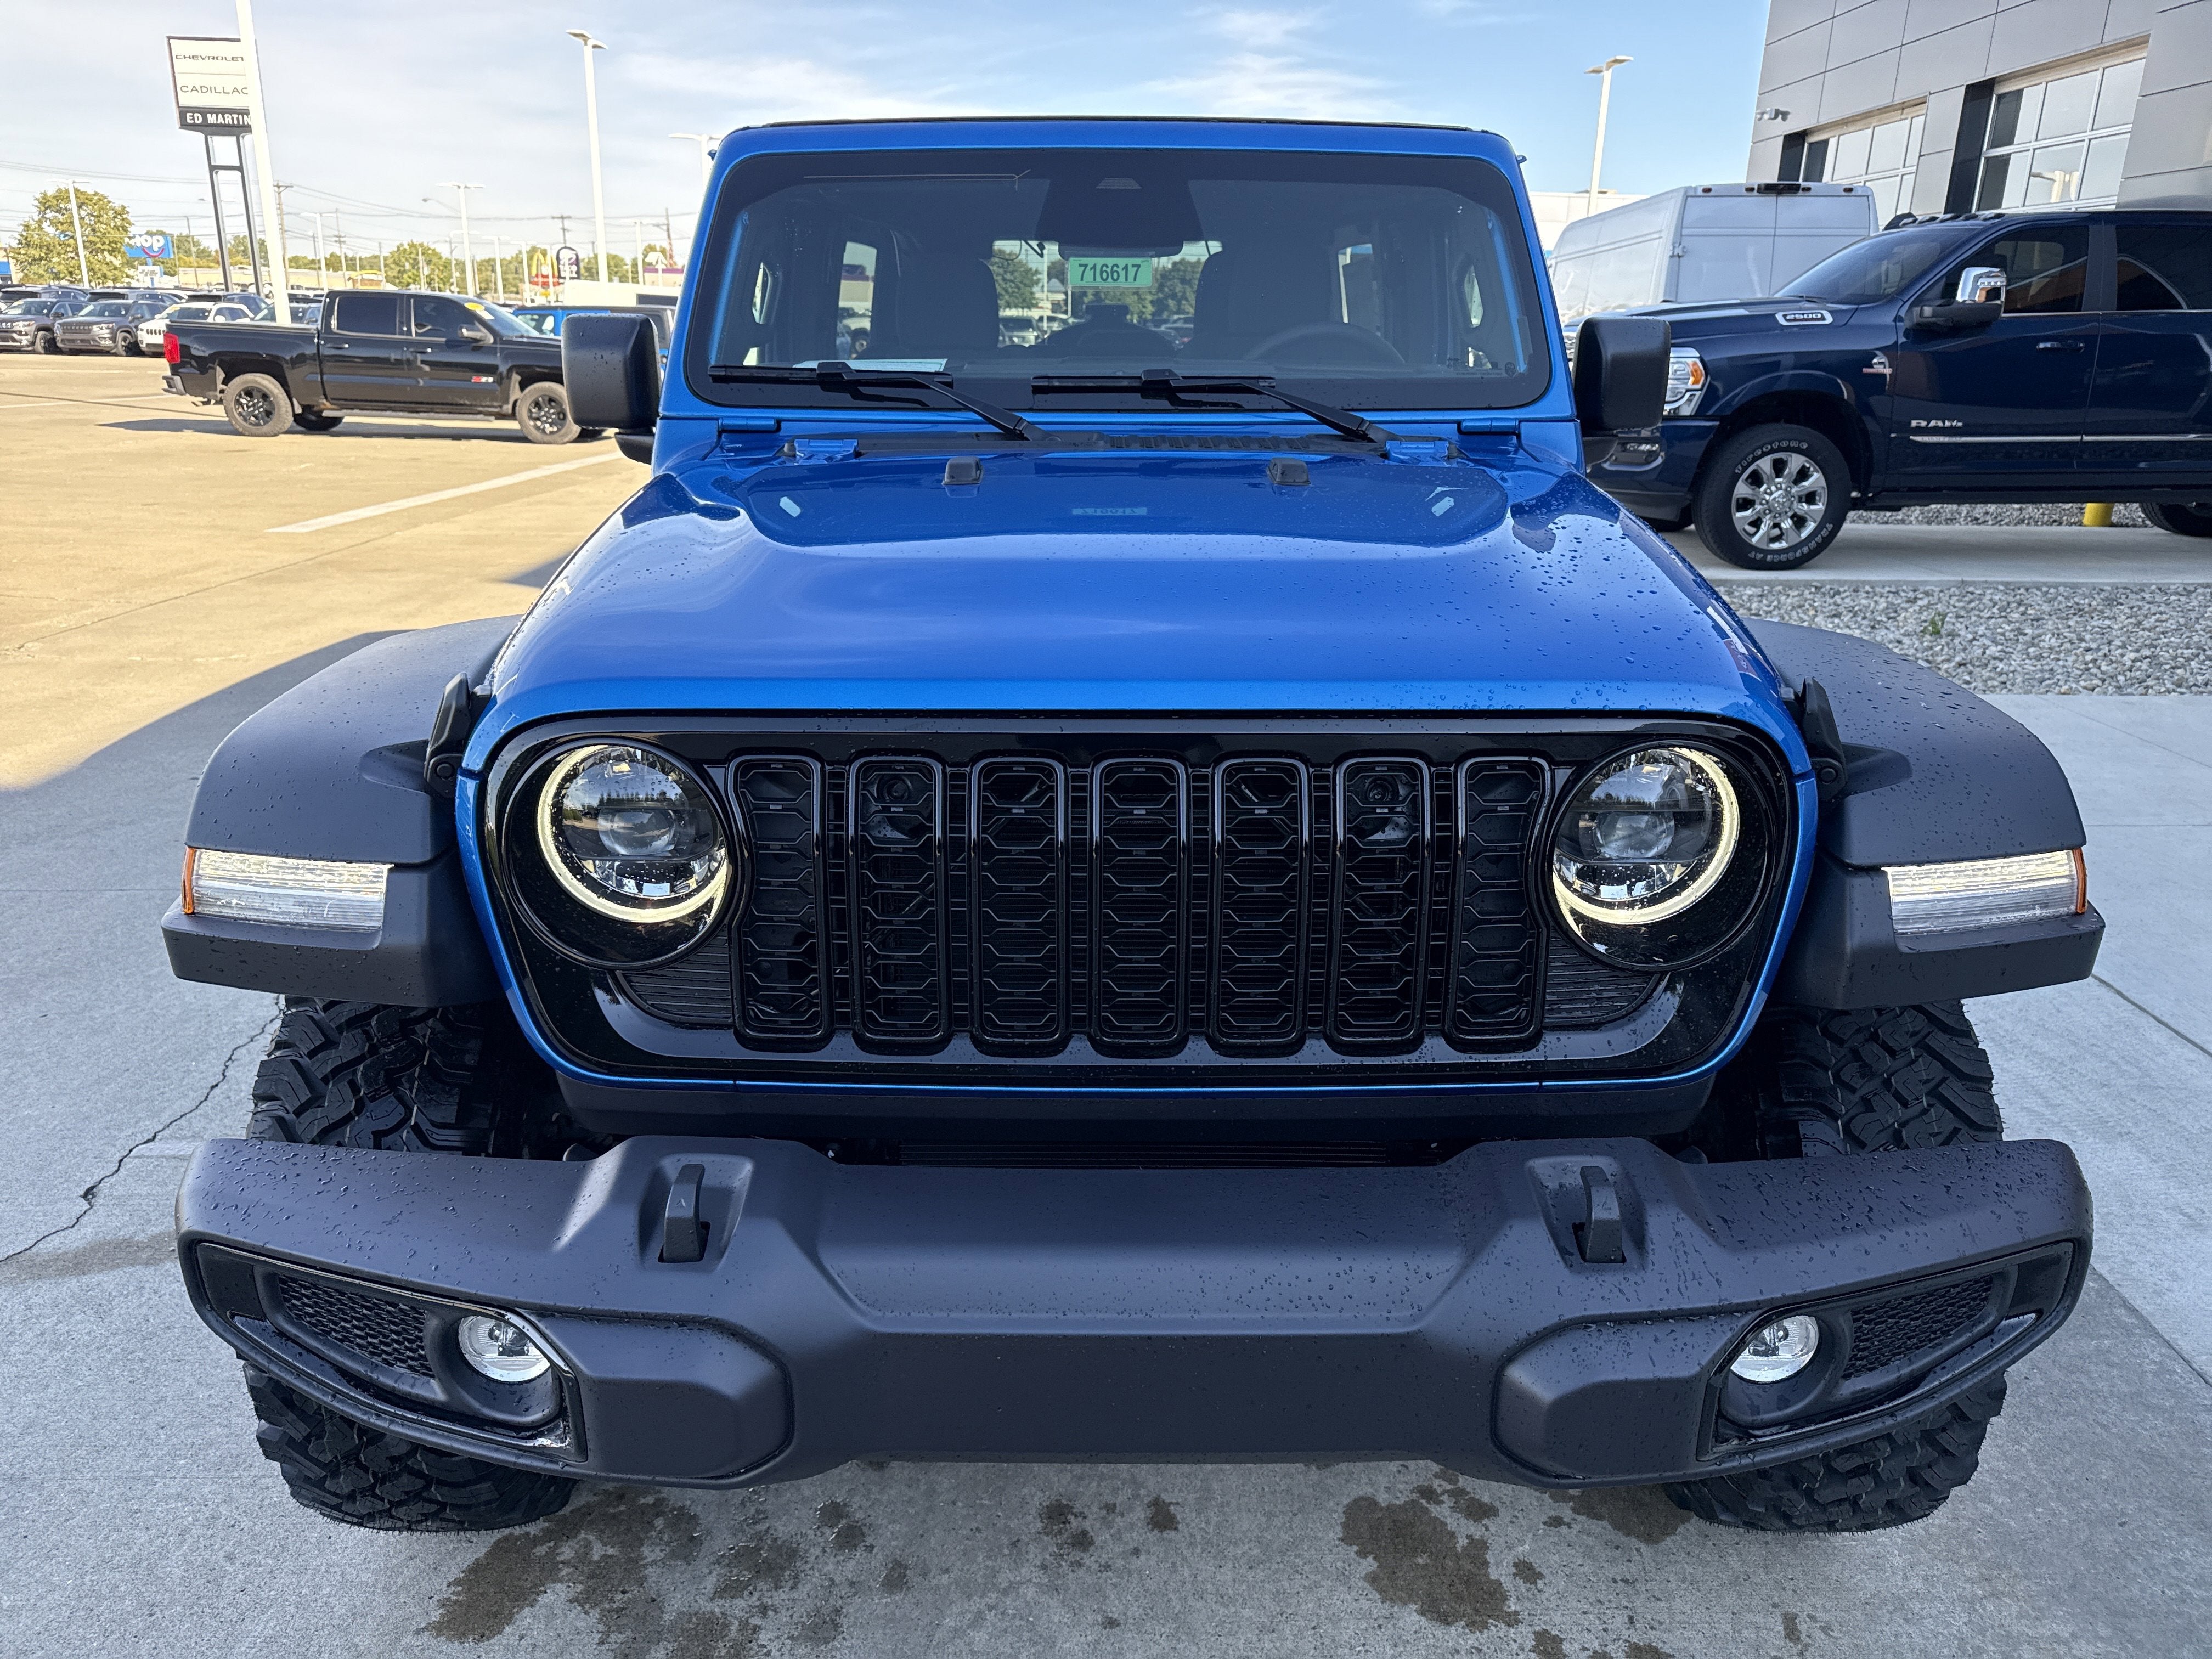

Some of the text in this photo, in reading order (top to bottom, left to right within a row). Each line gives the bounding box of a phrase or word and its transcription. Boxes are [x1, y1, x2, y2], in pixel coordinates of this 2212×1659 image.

[180, 85, 249, 95] CADILLAC
[186, 112, 251, 125] ED MARTIN
[1079, 263, 1141, 281] 716617
